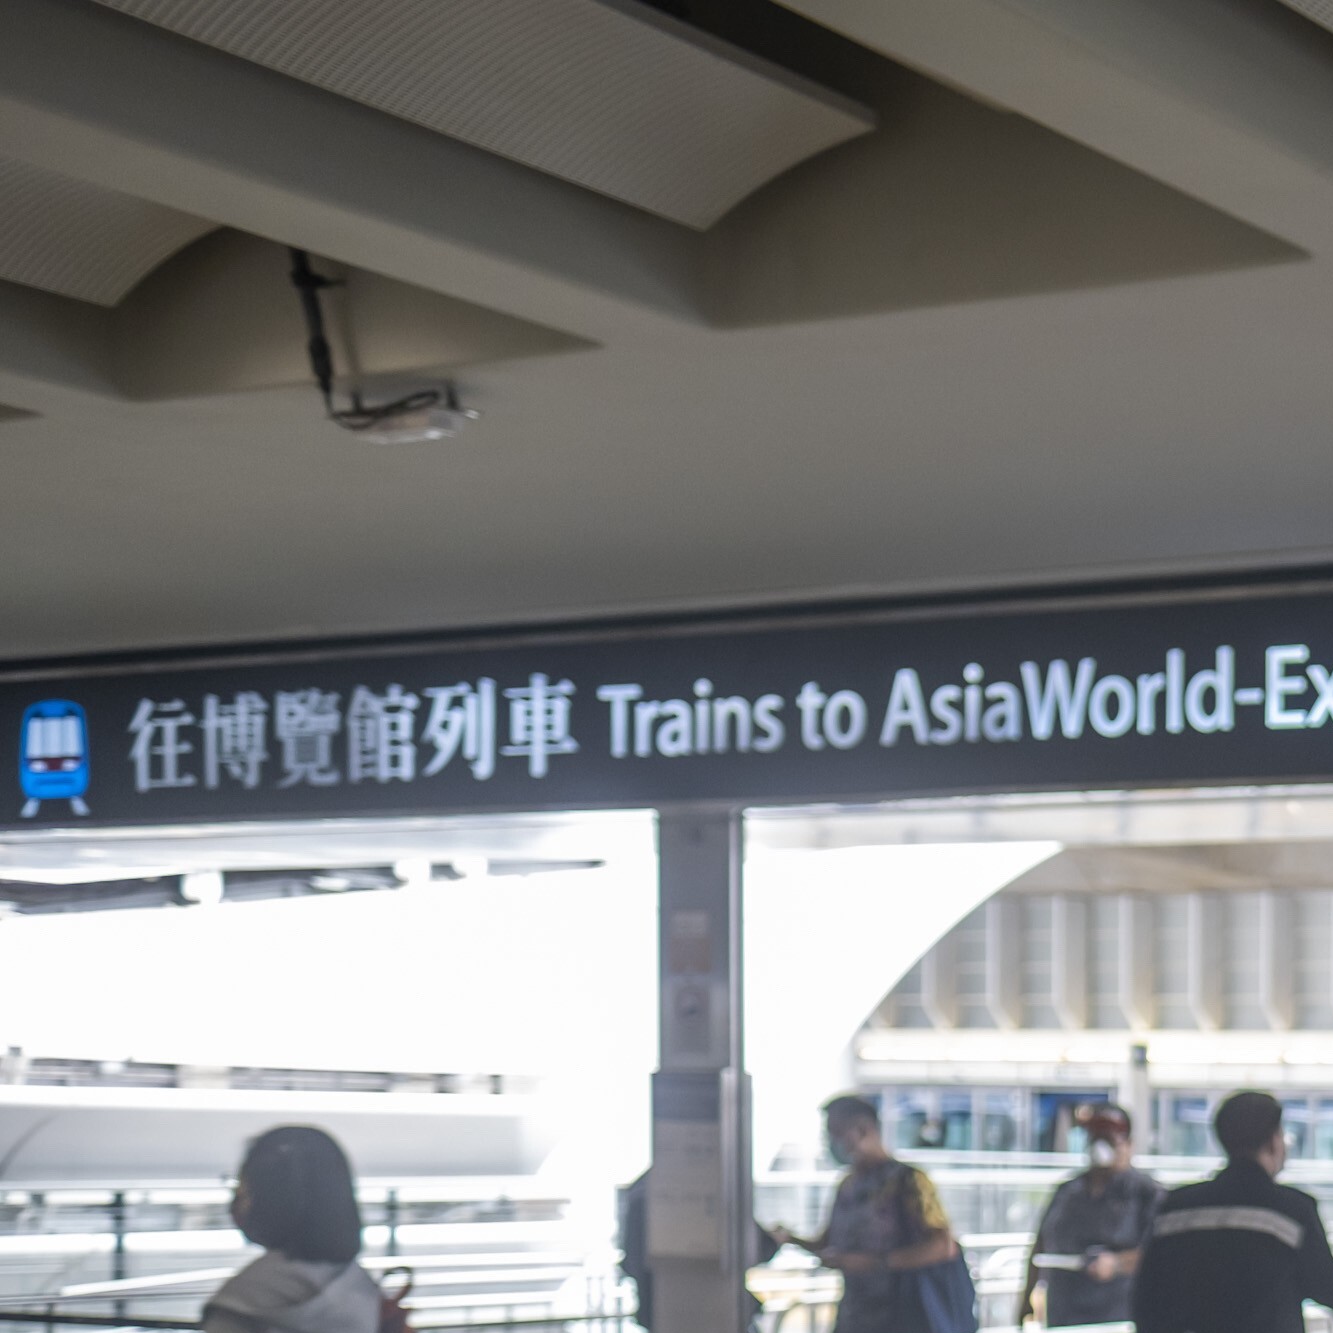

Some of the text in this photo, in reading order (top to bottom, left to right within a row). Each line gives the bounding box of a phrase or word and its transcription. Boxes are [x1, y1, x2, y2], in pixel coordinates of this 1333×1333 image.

[129, 673, 579, 793] 往博覽館列車
[597, 679, 783, 757] Trains
[796, 682, 865, 749] to
